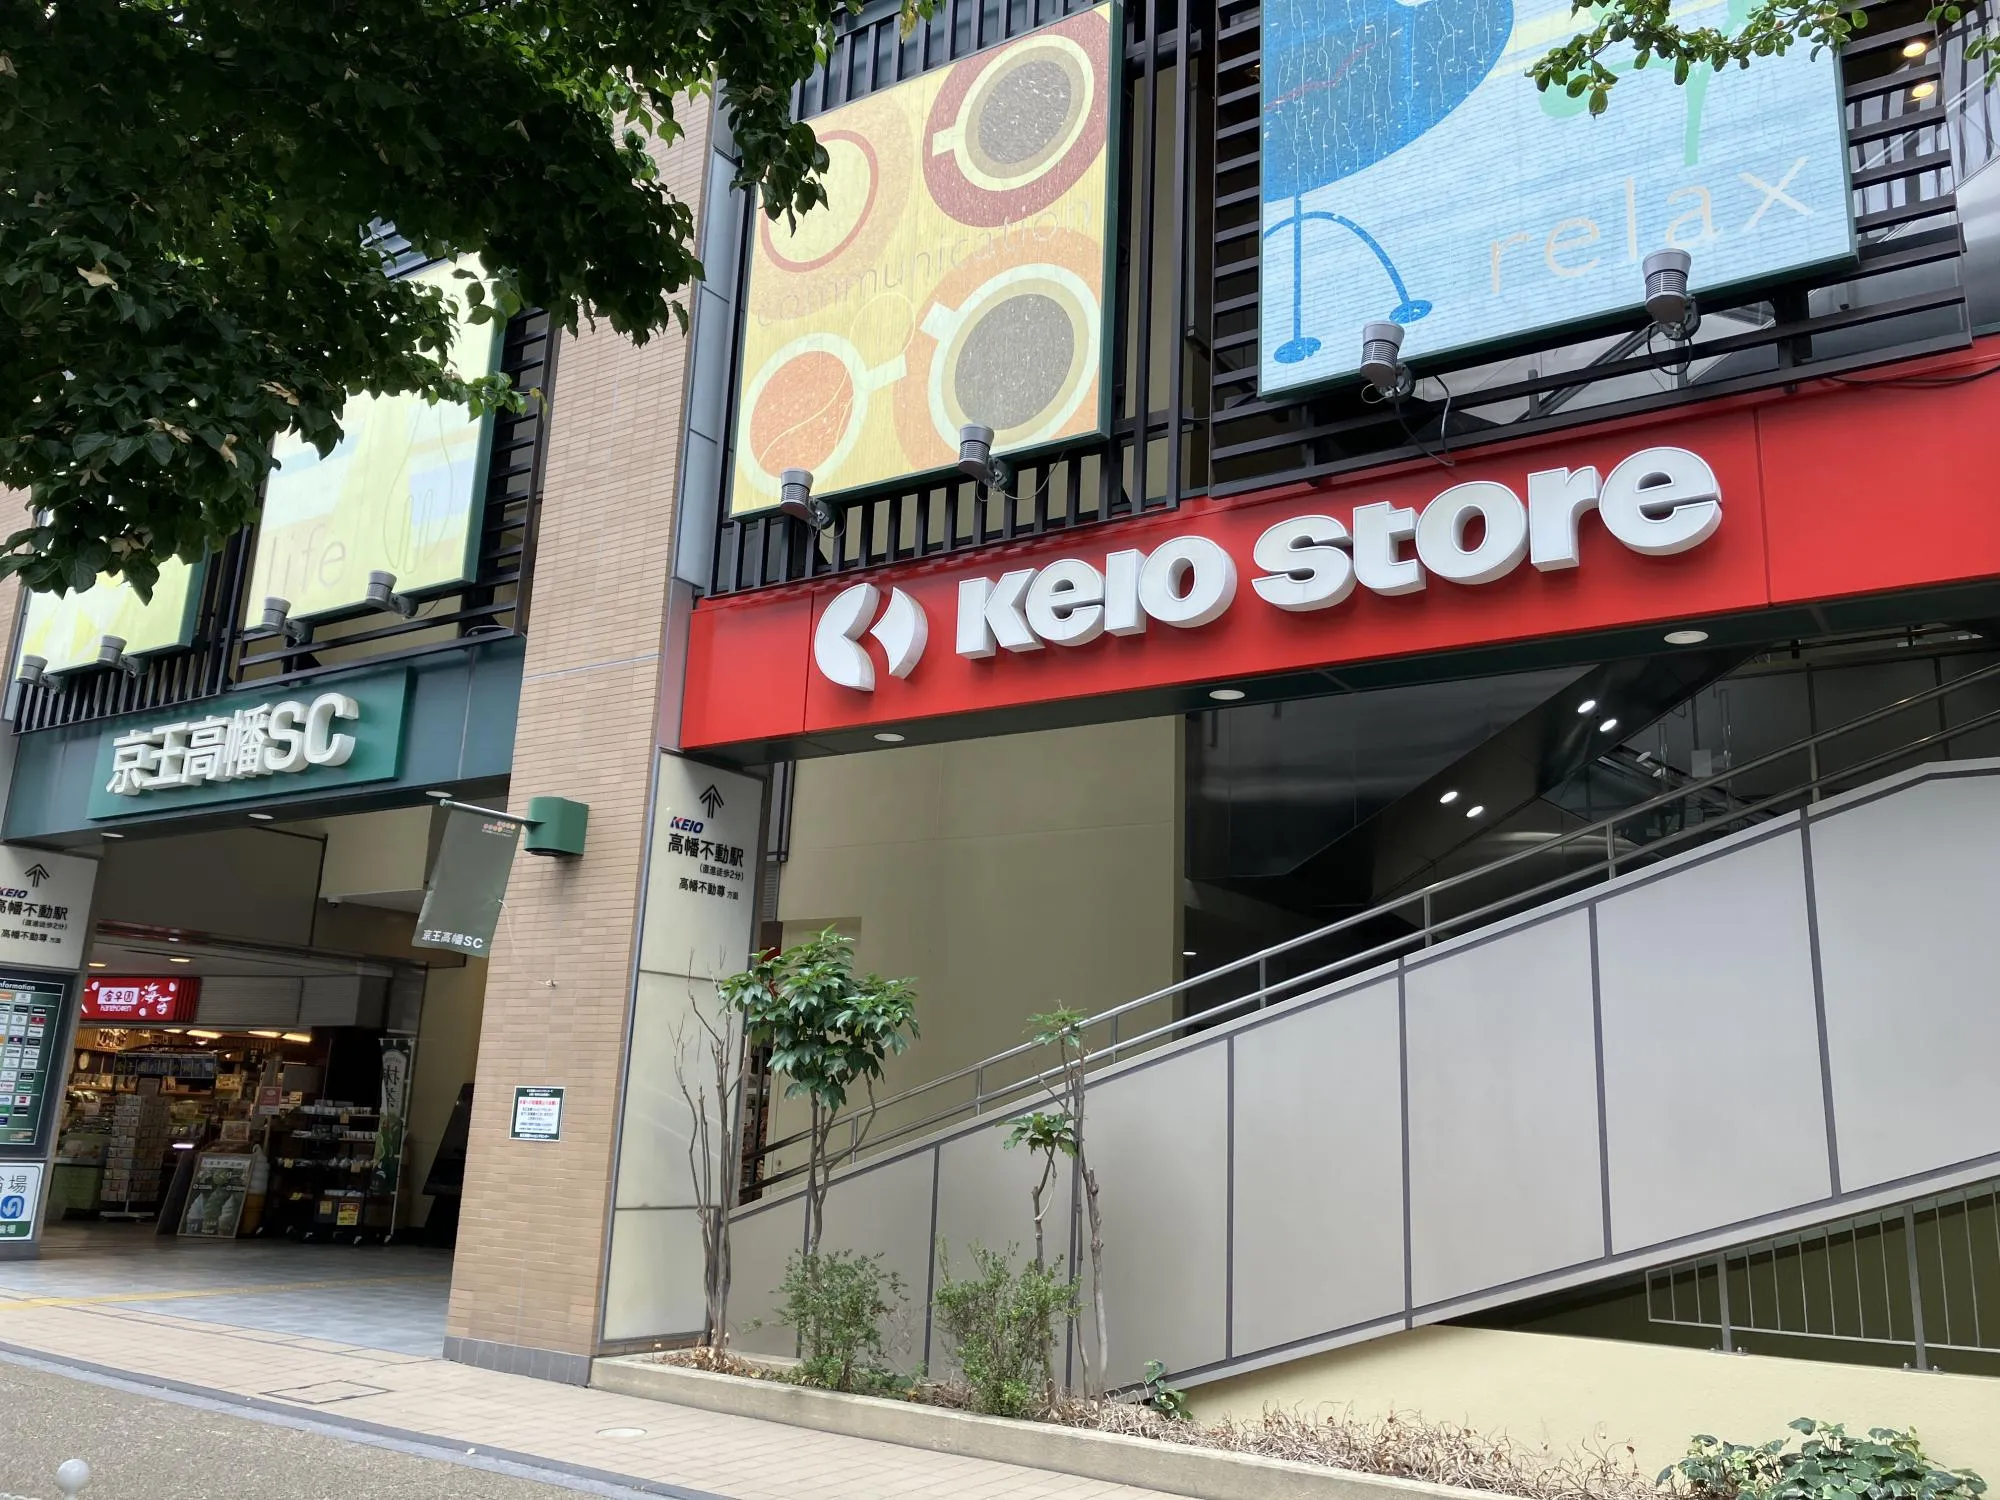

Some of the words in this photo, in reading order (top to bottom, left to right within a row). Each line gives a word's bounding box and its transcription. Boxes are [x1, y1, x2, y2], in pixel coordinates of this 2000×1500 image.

[1488, 155, 1815, 295] relax
[1252, 446, 1723, 612] store
[266, 522, 346, 597] life
[106, 692, 359, 796] 京王高幡SC
[668, 832, 744, 868] 高幡不動駅
[670, 816, 704, 834] KEIO
[678, 877, 726, 898] 高幡不動尊
[421, 929, 484, 949] 京王高幡SC
